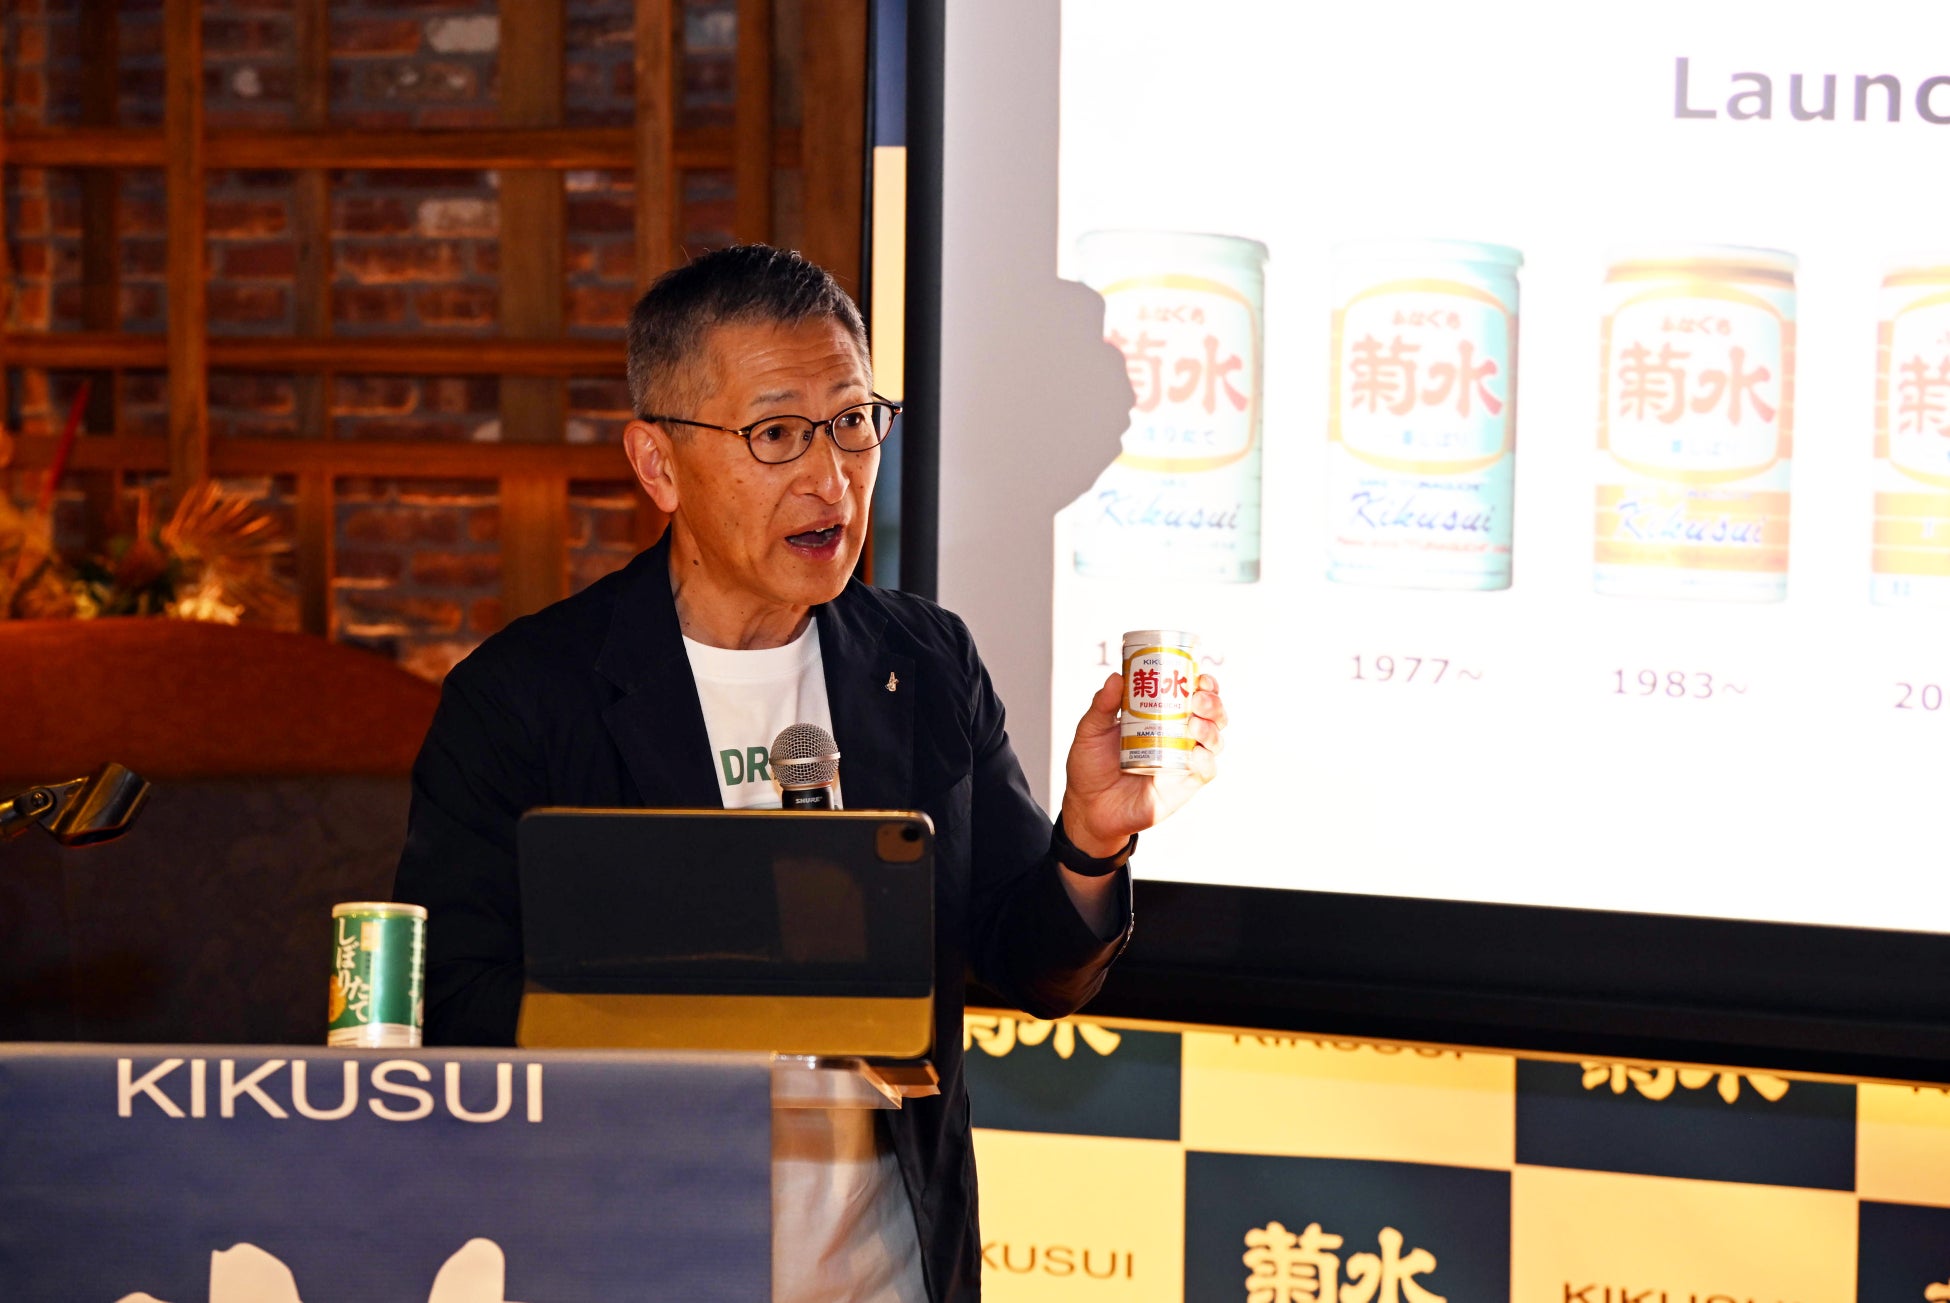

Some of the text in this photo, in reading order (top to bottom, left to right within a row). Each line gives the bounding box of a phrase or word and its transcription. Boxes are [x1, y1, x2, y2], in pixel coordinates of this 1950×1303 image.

[1349, 332, 1504, 419] 菊水
[1618, 340, 1777, 428] 菊水
[1098, 488, 1242, 530] Kikusui
[1350, 490, 1496, 533] Kikusui
[1615, 501, 1768, 543] Kikusui
[1132, 668, 1190, 699] 菊水
[1139, 702, 1182, 710] FUNAGUCHI
[795, 796, 822, 805] SHURE
[335, 916, 371, 1023] しぼりたて
[117, 1058, 543, 1123] KIKUSUI
